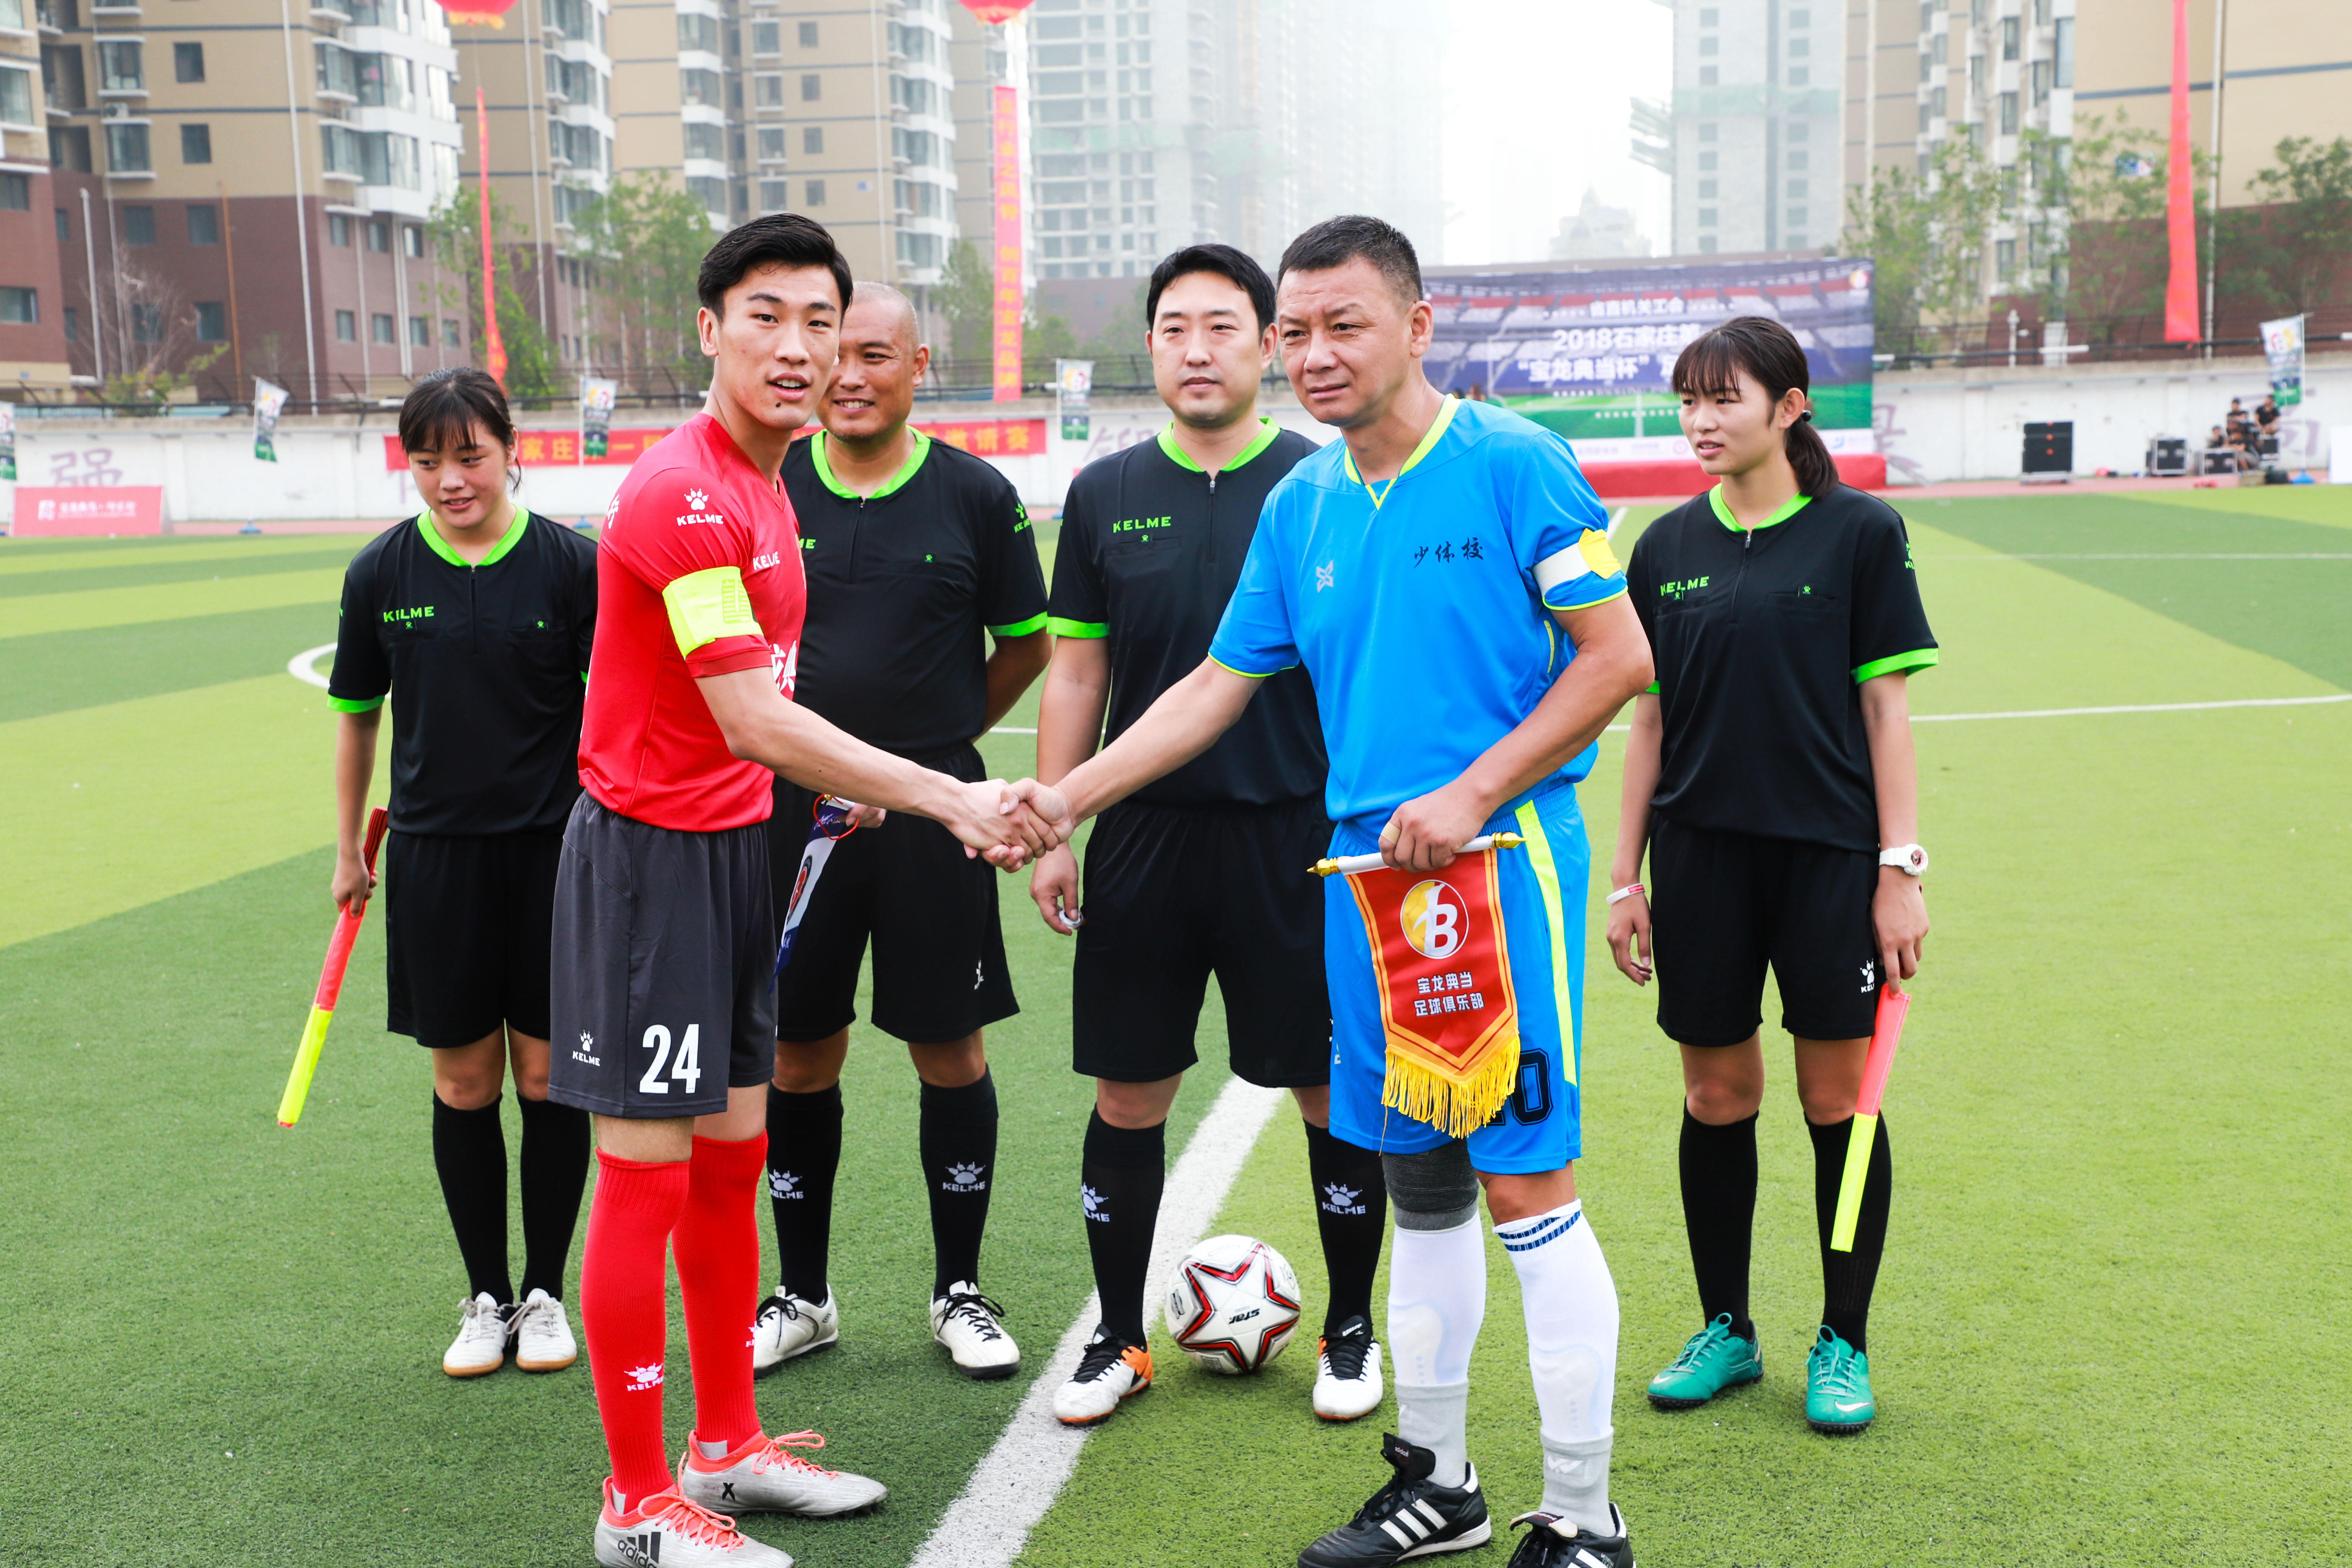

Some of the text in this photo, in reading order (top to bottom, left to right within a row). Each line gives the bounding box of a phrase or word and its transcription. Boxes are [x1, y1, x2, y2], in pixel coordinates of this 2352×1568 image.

[677, 514, 724, 526] KELME
[1113, 516, 1172, 533] KELME
[1413, 537, 1484, 569] 少体校
[1417, 971, 1473, 995] 宝龙典当
[1414, 992, 1484, 1017] 足球俱乐部
[572, 1050, 600, 1066] KELME
[639, 1024, 701, 1094] 24
[943, 1181, 986, 1192] KELME
[1322, 1202, 1366, 1215] KELME
